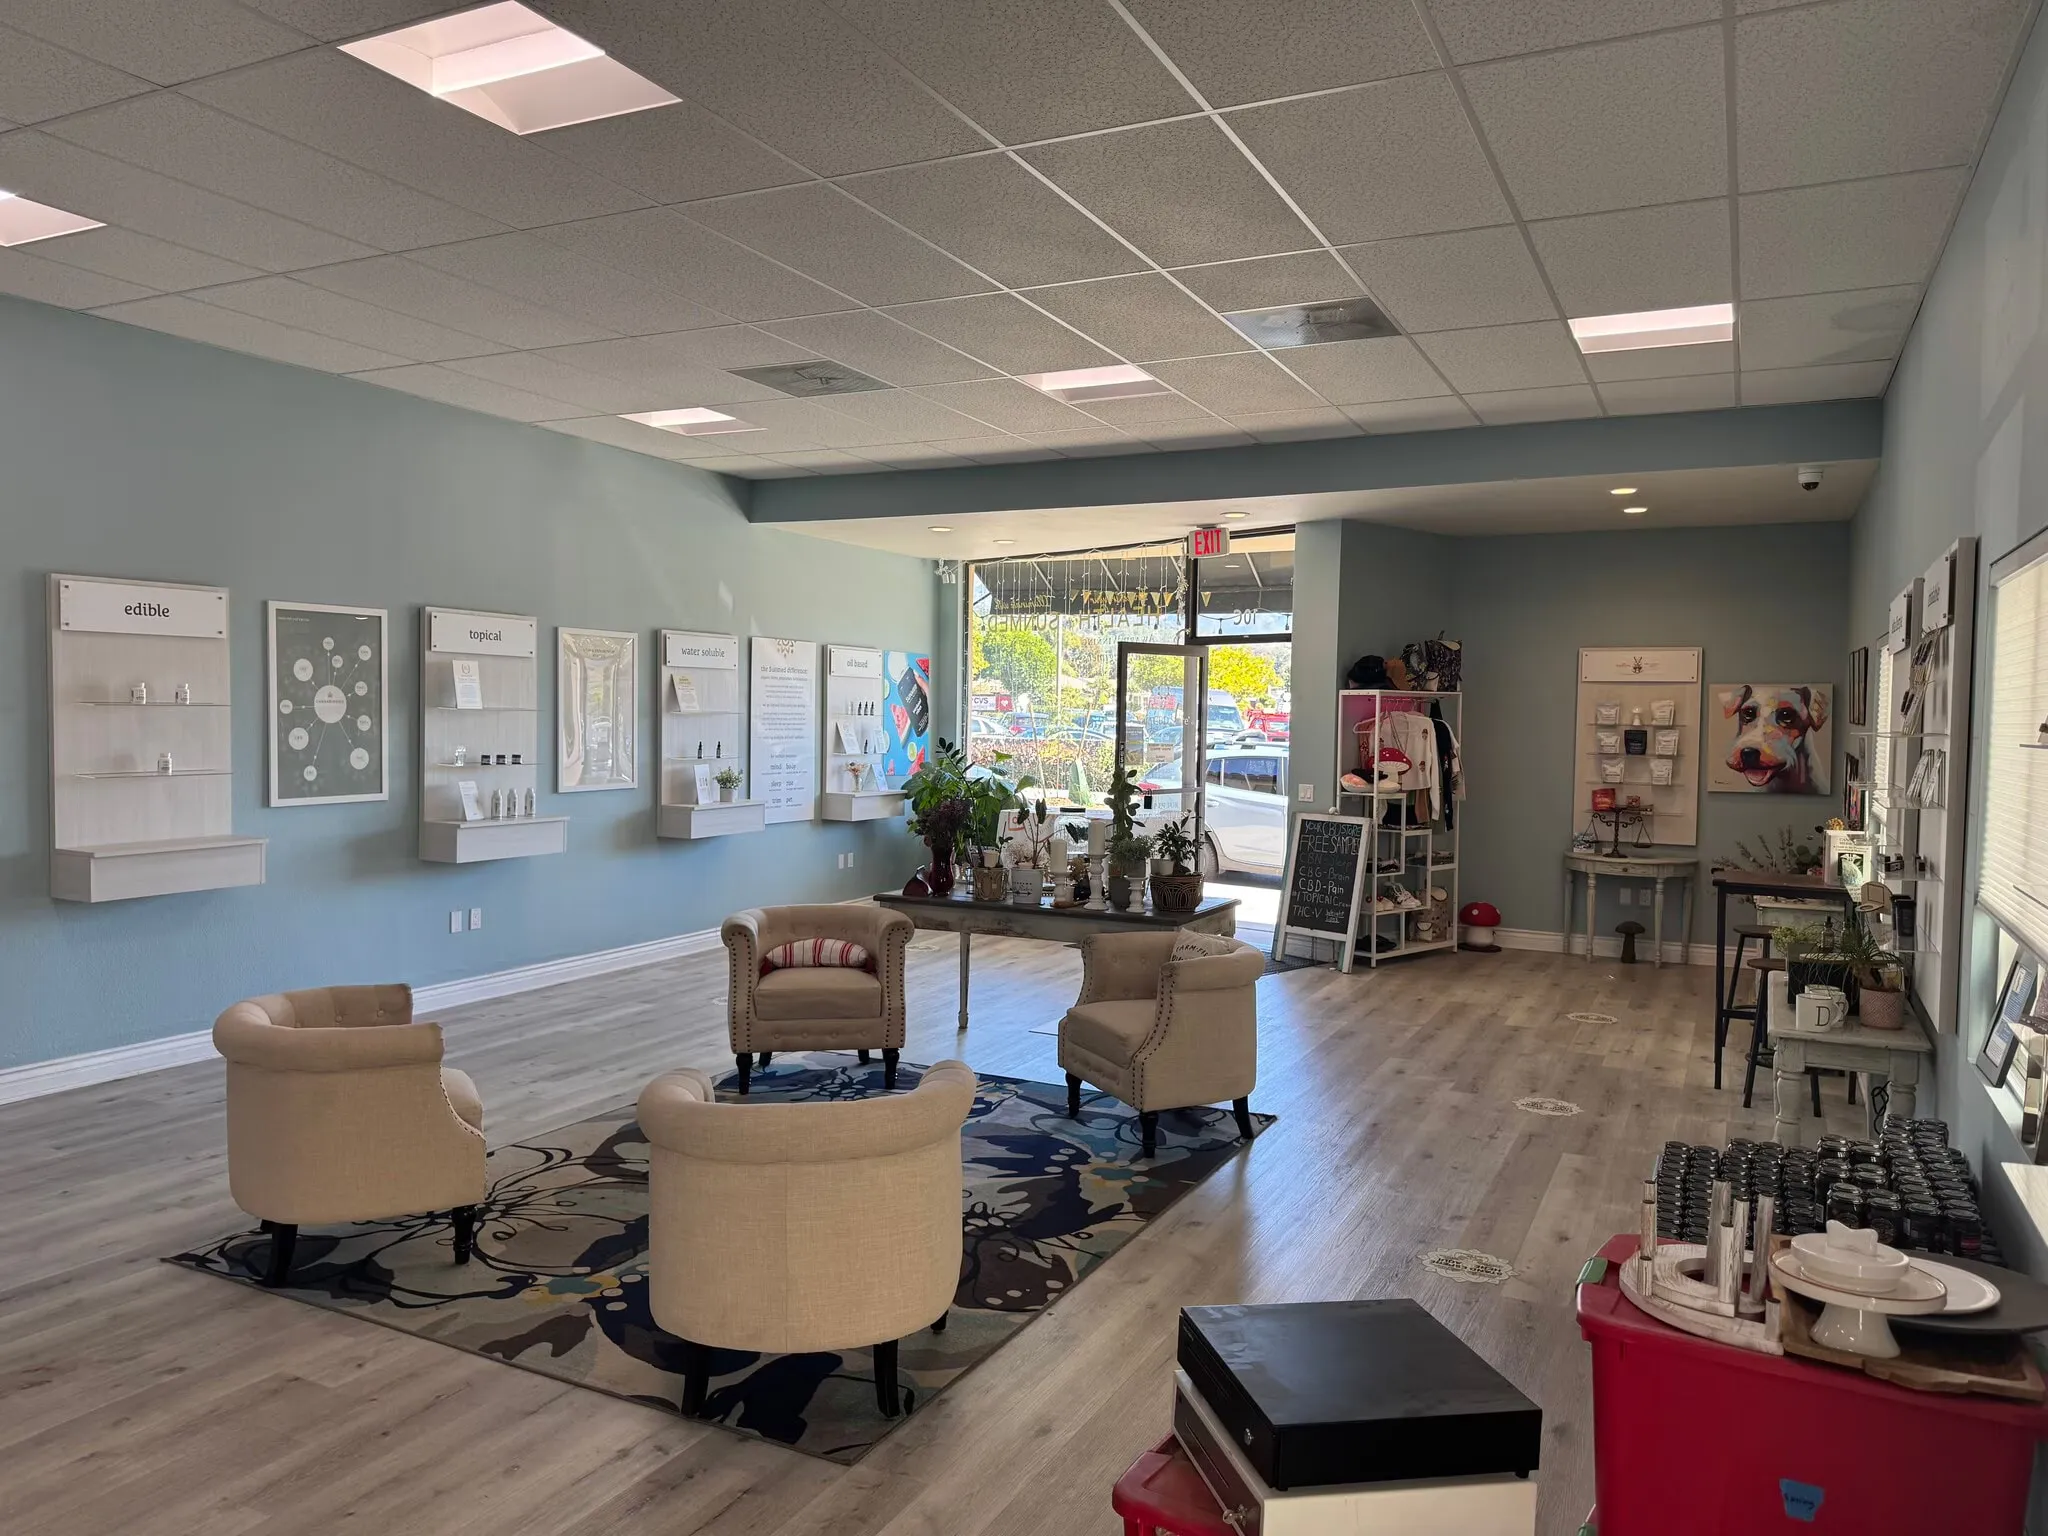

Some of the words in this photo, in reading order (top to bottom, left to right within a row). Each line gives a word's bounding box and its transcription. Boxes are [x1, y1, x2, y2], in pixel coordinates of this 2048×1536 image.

[1194, 529, 1221, 555] EXIT
[124, 602, 170, 618] edible
[469, 630, 502, 642] topical
[681, 648, 700, 656] water
[701, 648, 725, 658] soluble
[854, 660, 868, 668] based
[1305, 820, 1322, 833] YOUR
[1300, 834, 1330, 853] FREE
[1815, 1005, 1831, 1027] D
